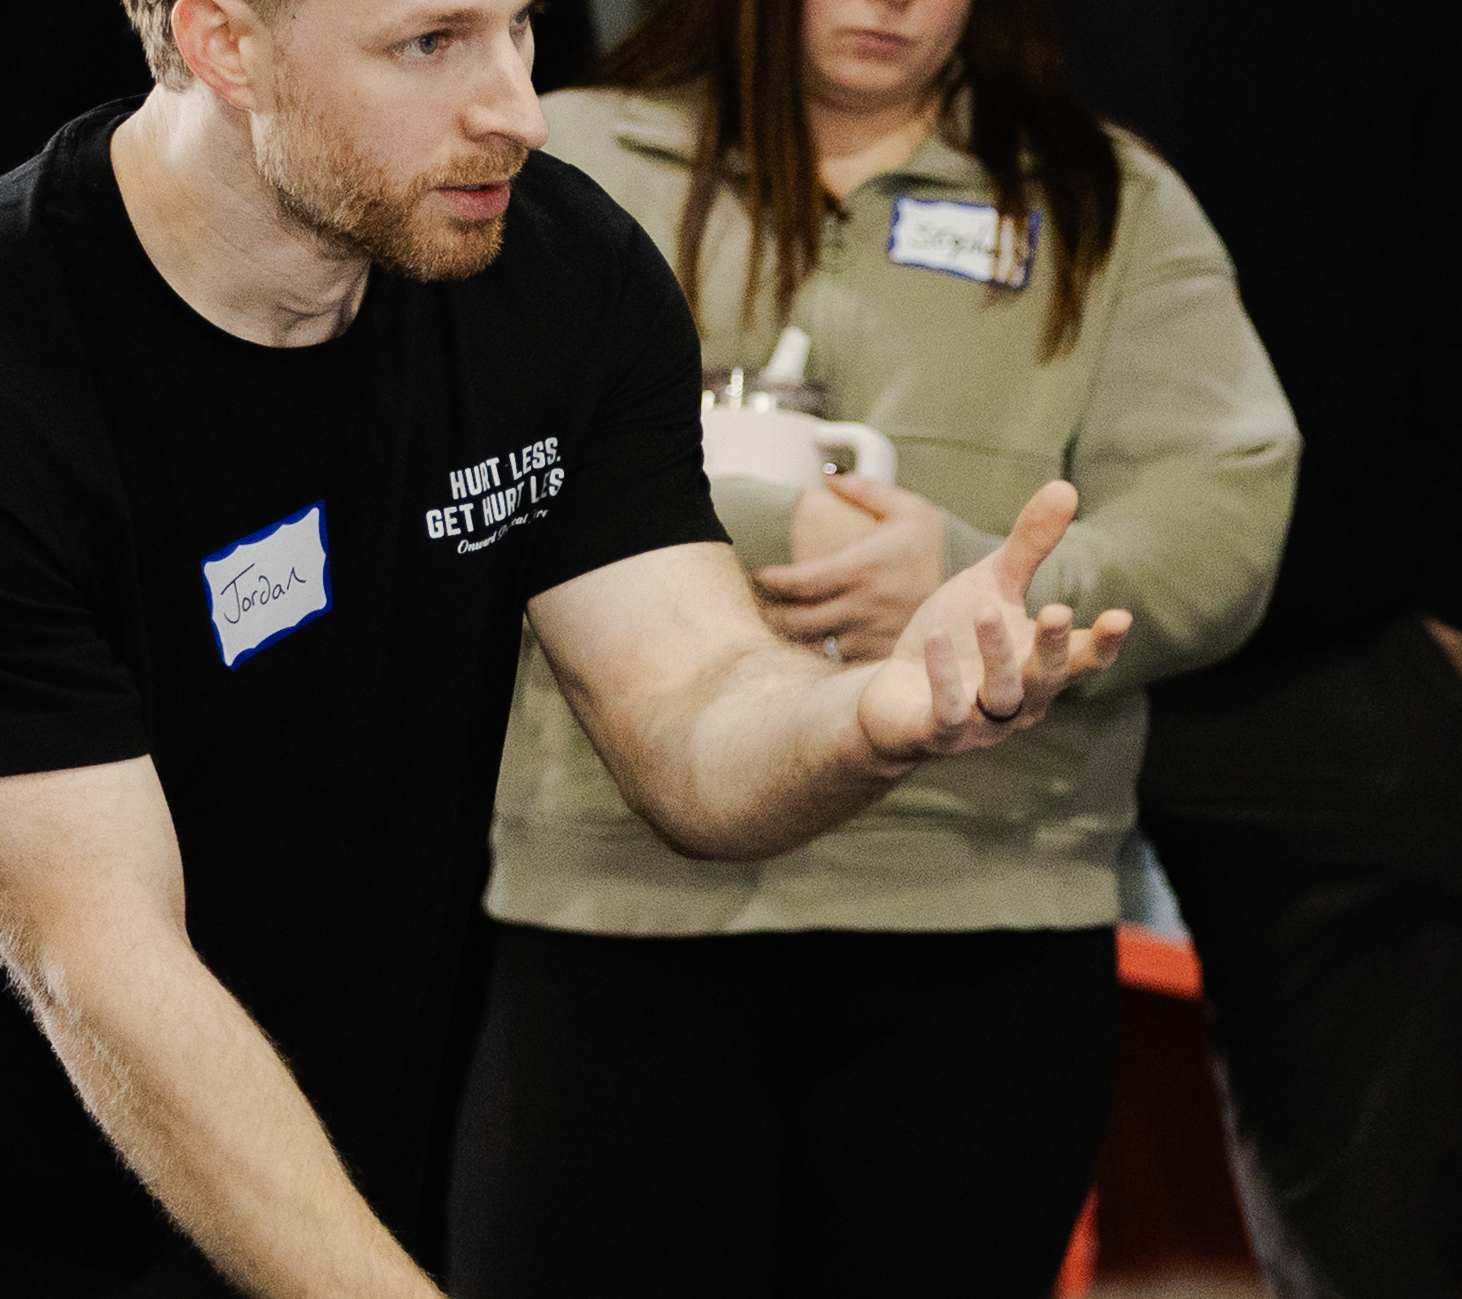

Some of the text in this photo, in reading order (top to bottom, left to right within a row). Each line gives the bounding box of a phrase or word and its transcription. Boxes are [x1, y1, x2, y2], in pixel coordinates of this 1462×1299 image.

[449, 436, 562, 501] HURT LESS.
[425, 502, 475, 540] GET
[481, 480, 526, 527] HURT
[220, 561, 307, 625] Jordan
